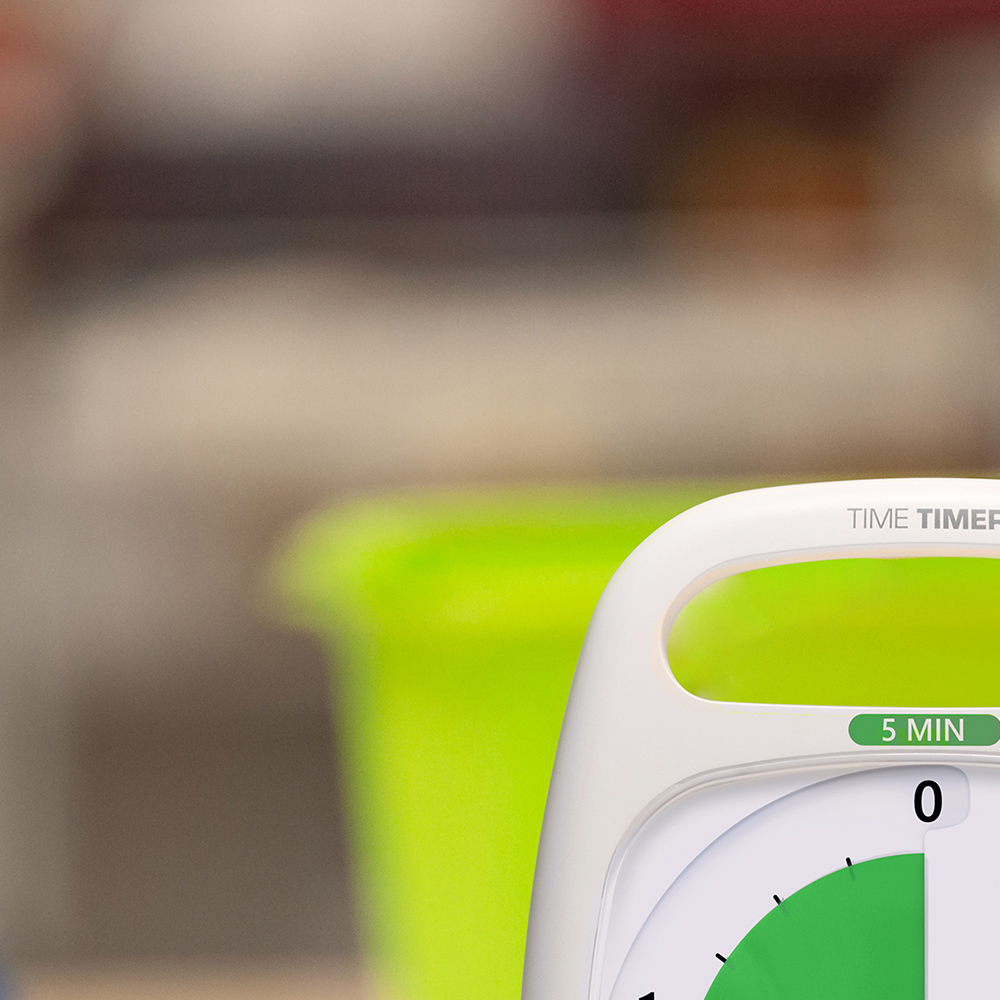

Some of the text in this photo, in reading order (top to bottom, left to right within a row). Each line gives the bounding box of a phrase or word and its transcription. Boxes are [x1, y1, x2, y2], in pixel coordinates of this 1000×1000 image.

[847, 507, 909, 529] TIME
[882, 718, 964, 742] 5 MIN
[913, 779, 943, 823] 0
